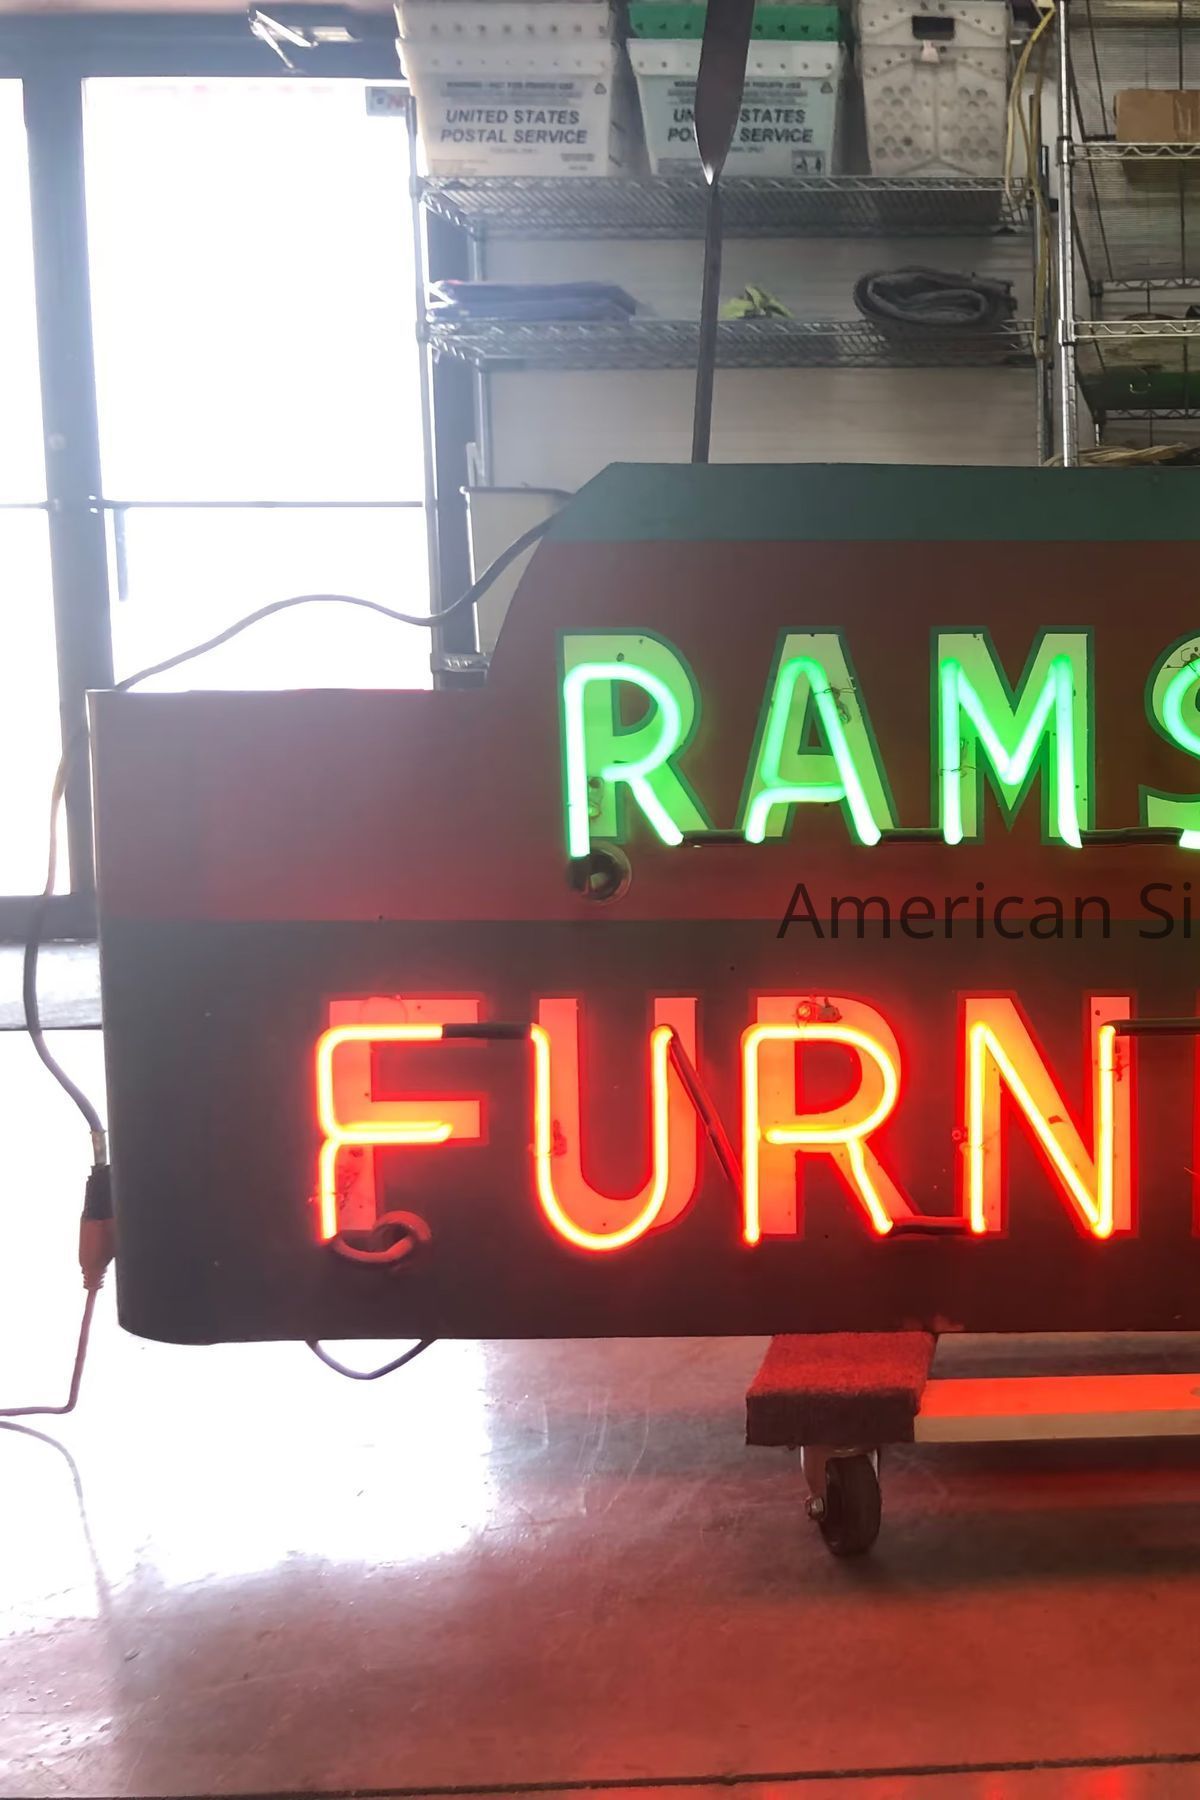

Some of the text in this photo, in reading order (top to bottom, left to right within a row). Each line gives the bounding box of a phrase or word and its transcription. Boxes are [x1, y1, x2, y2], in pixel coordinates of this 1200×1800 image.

[446, 109, 580, 125] UNITED STATES
[740, 108, 806, 124] STATES
[440, 129, 588, 144] POSTAL SERVICE
[740, 128, 814, 143] SERVICE
